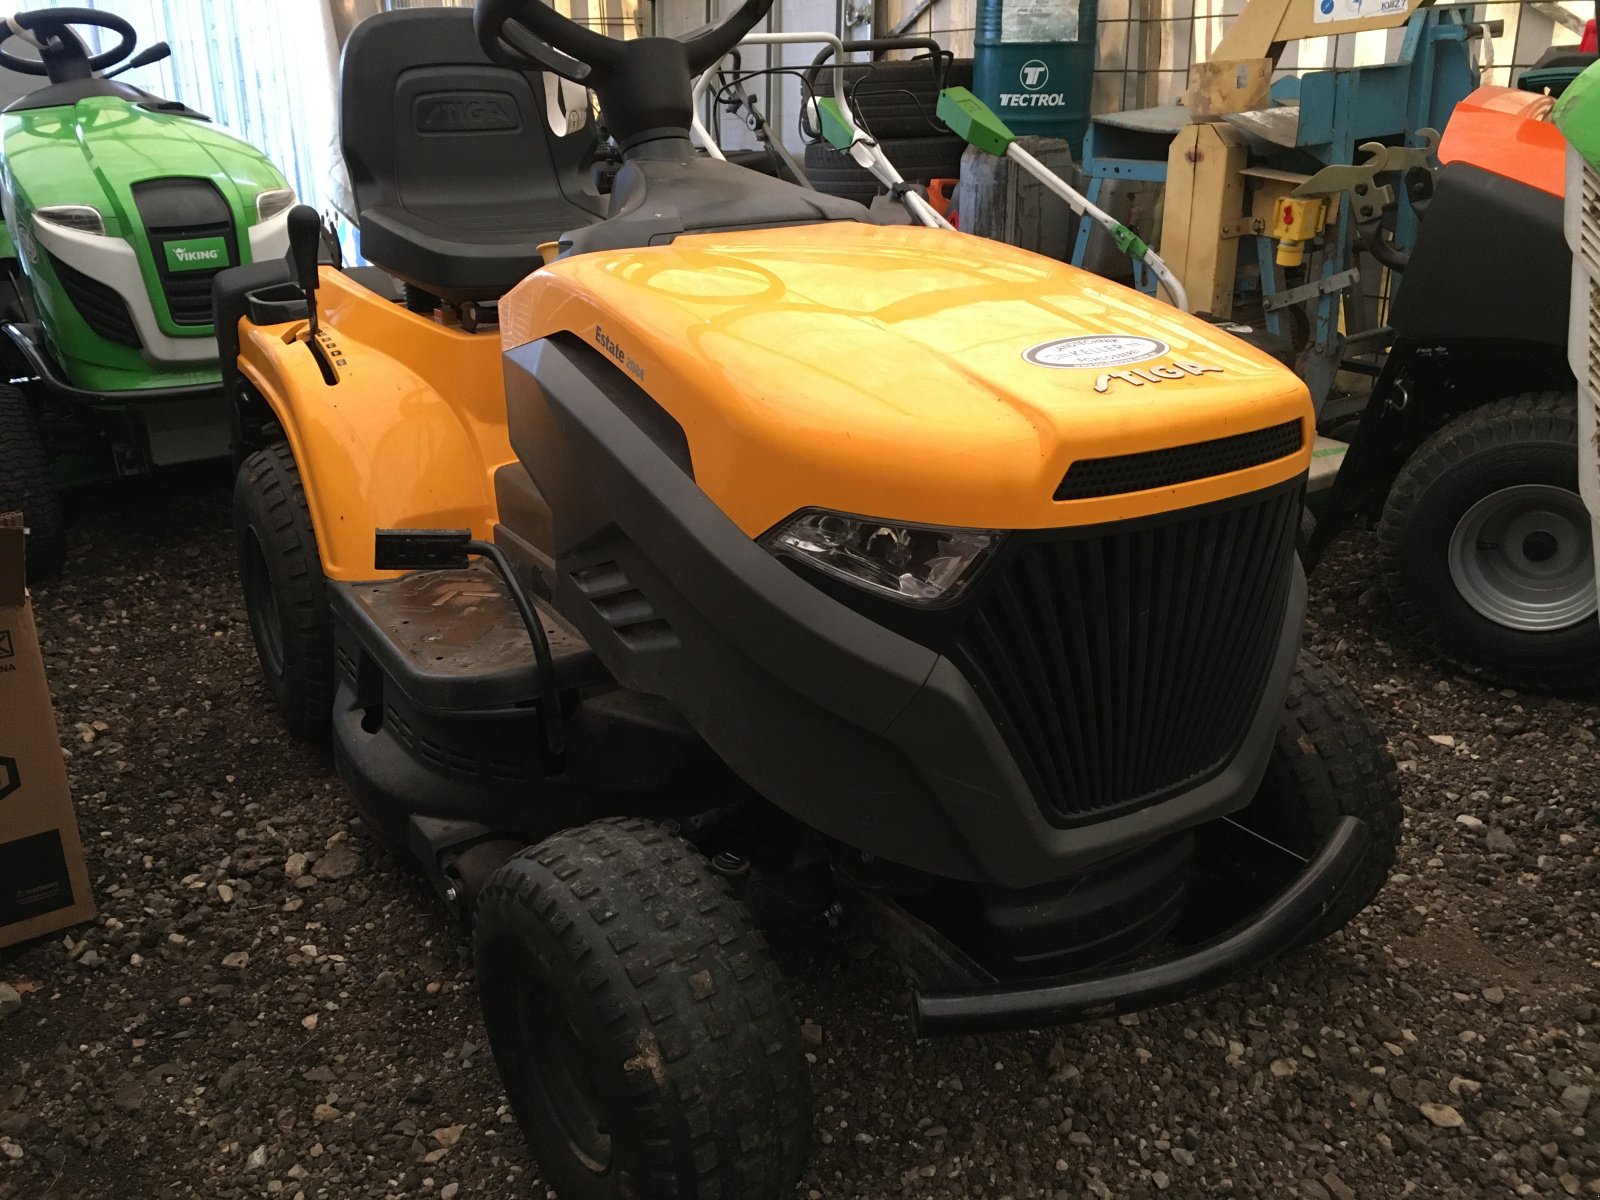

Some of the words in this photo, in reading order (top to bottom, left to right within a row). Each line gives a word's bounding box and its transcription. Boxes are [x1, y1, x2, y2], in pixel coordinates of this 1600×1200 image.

[999, 93, 1065, 106] TECTROL
[176, 250, 218, 262] VIKING
[595, 324, 625, 364] Estate
[1070, 343, 1124, 357] KELLER
[1094, 361, 1224, 394] STIGA
